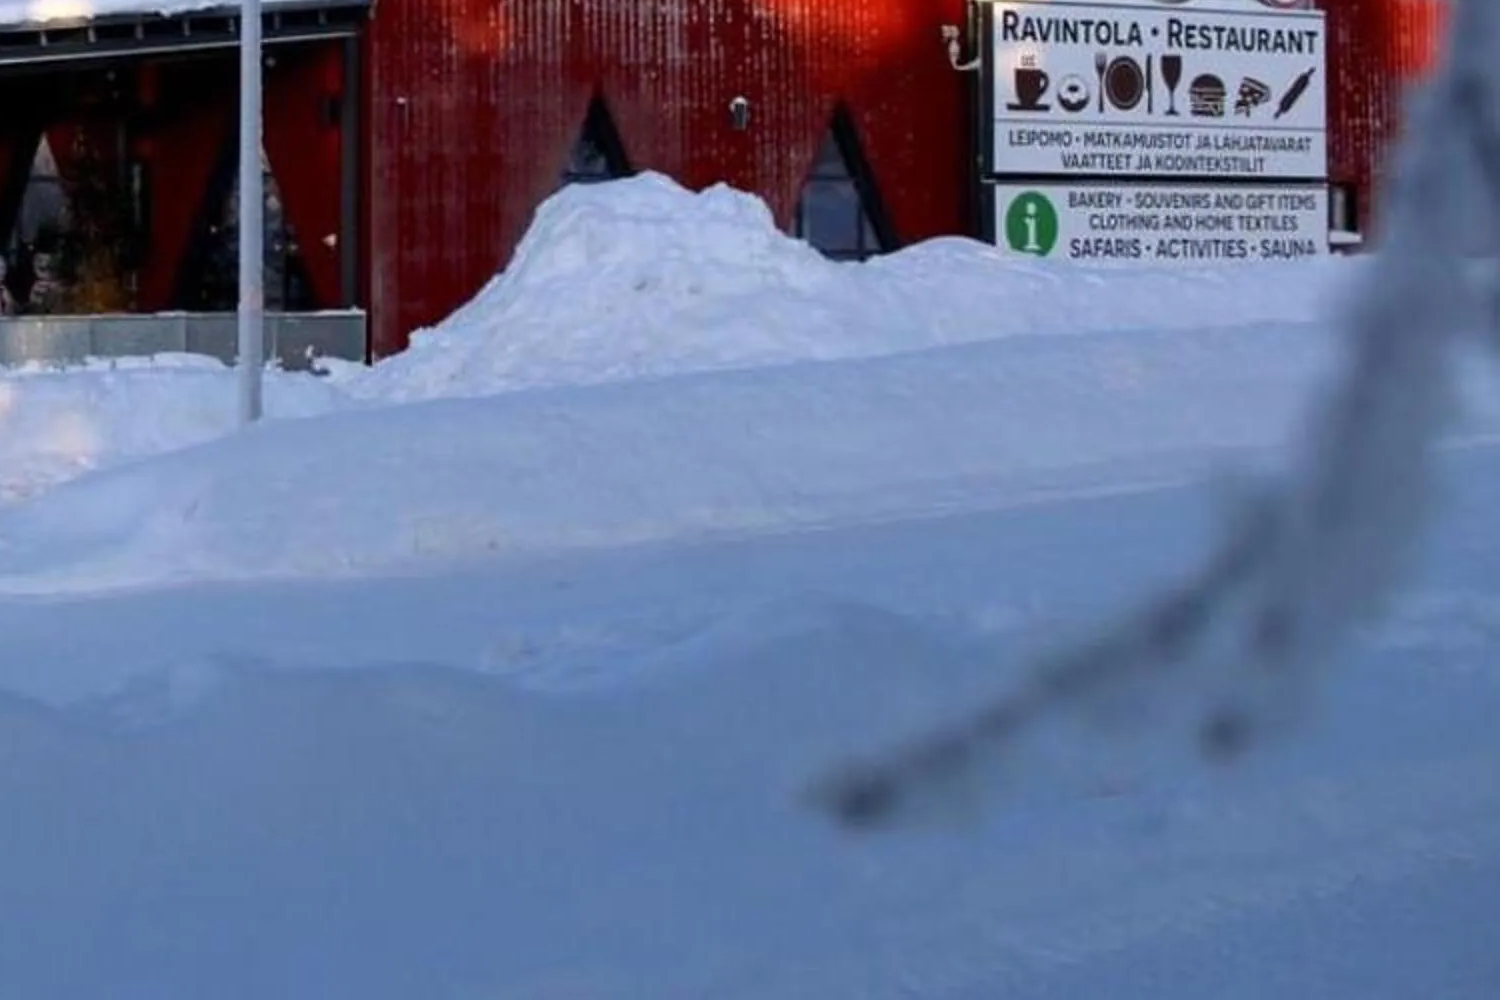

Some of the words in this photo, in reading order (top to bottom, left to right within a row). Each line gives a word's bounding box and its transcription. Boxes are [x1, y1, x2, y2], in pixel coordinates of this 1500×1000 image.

[1002, 9, 1143, 46] RAVINTOLA
[1167, 17, 1319, 54] RESTAURANT
[1009, 129, 1073, 147] LEIPOMO
[1083, 131, 1191, 150] MATKAMUISTOT
[1195, 134, 1211, 149] JA
[1061, 152, 1132, 170] VAATTEET
[1136, 154, 1152, 170] JA
[1068, 191, 1122, 208] BAKERY
[1134, 191, 1211, 209] SOUVENIRS
[1215, 194, 1243, 210] AND
[1246, 194, 1275, 210] GIFT
[1278, 194, 1317, 210] ITEMS
[1089, 213, 1160, 231] CLOTHING
[1164, 214, 1193, 231] AND
[1196, 215, 1233, 231] HOME
[1238, 215, 1299, 232] TEXTILES
[1070, 238, 1141, 258] SAFARIS
[1155, 239, 1248, 258] ACTIVITIES
[1260, 239, 1317, 258] SAUNA
